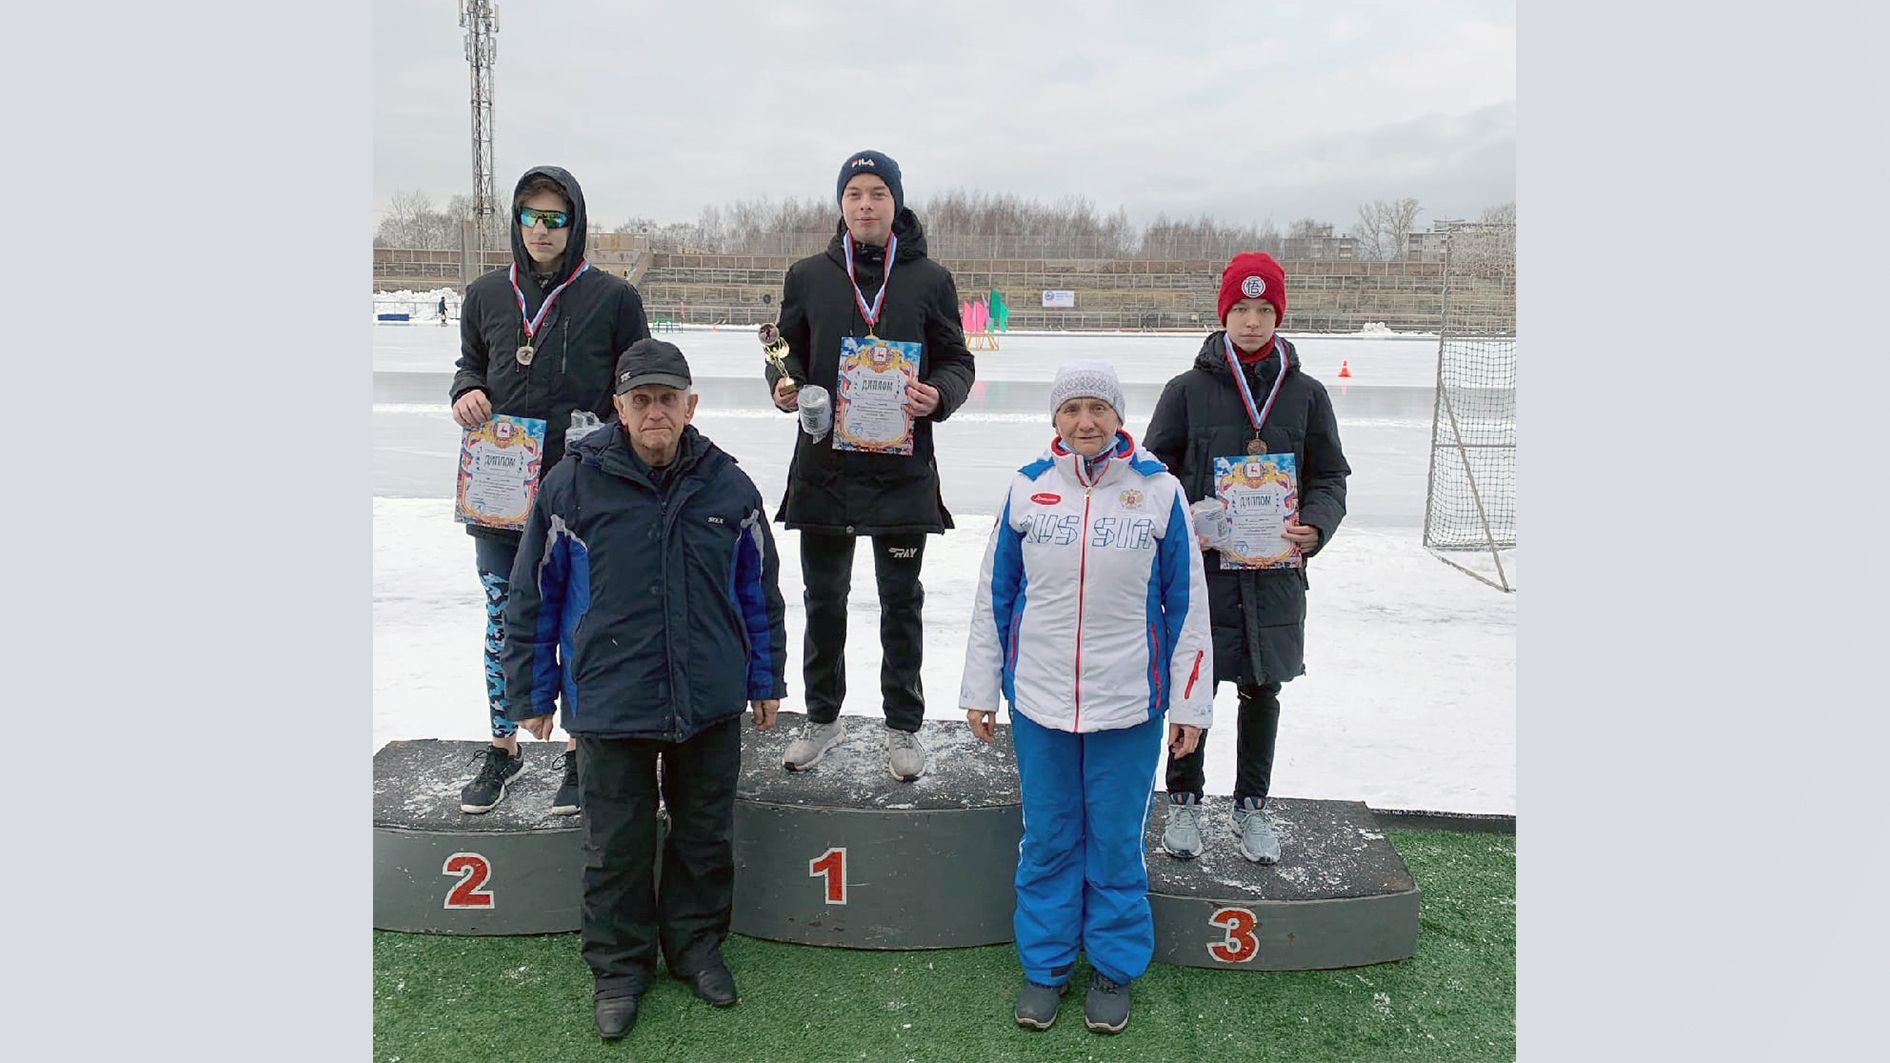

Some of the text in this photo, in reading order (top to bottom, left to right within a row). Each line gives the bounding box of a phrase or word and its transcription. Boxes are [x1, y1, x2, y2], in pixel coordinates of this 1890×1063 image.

[851, 158, 875, 168] FILA
[862, 379, 893, 391] ДИПЛОМ
[484, 454, 516, 468] ДИПЛОМ
[1240, 495, 1272, 508] ДИПЛОМ
[888, 547, 918, 558] RAY
[442, 851, 495, 910] 2
[809, 847, 847, 905] 1
[1206, 907, 1260, 963] 3
